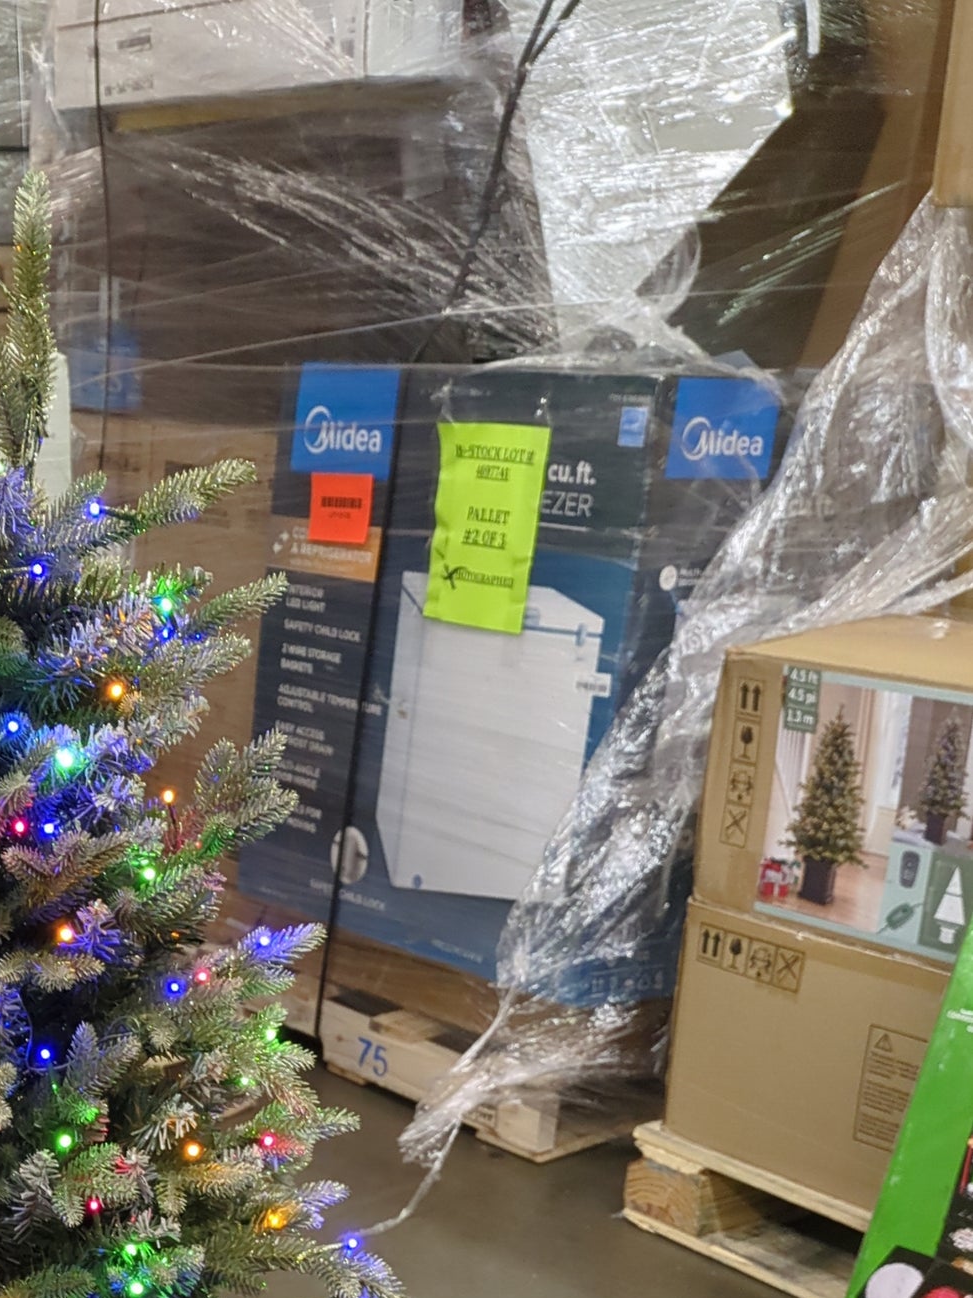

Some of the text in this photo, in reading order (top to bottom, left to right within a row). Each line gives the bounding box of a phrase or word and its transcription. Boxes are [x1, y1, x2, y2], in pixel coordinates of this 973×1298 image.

[304, 405, 382, 454] Midea
[681, 416, 764, 461] Midea
[547, 460, 596, 485] cu.ft.
[467, 506, 510, 525] PALLET
[540, 490, 594, 518] EZER
[481, 531, 497, 548] OF
[358, 1036, 388, 1078] 75
